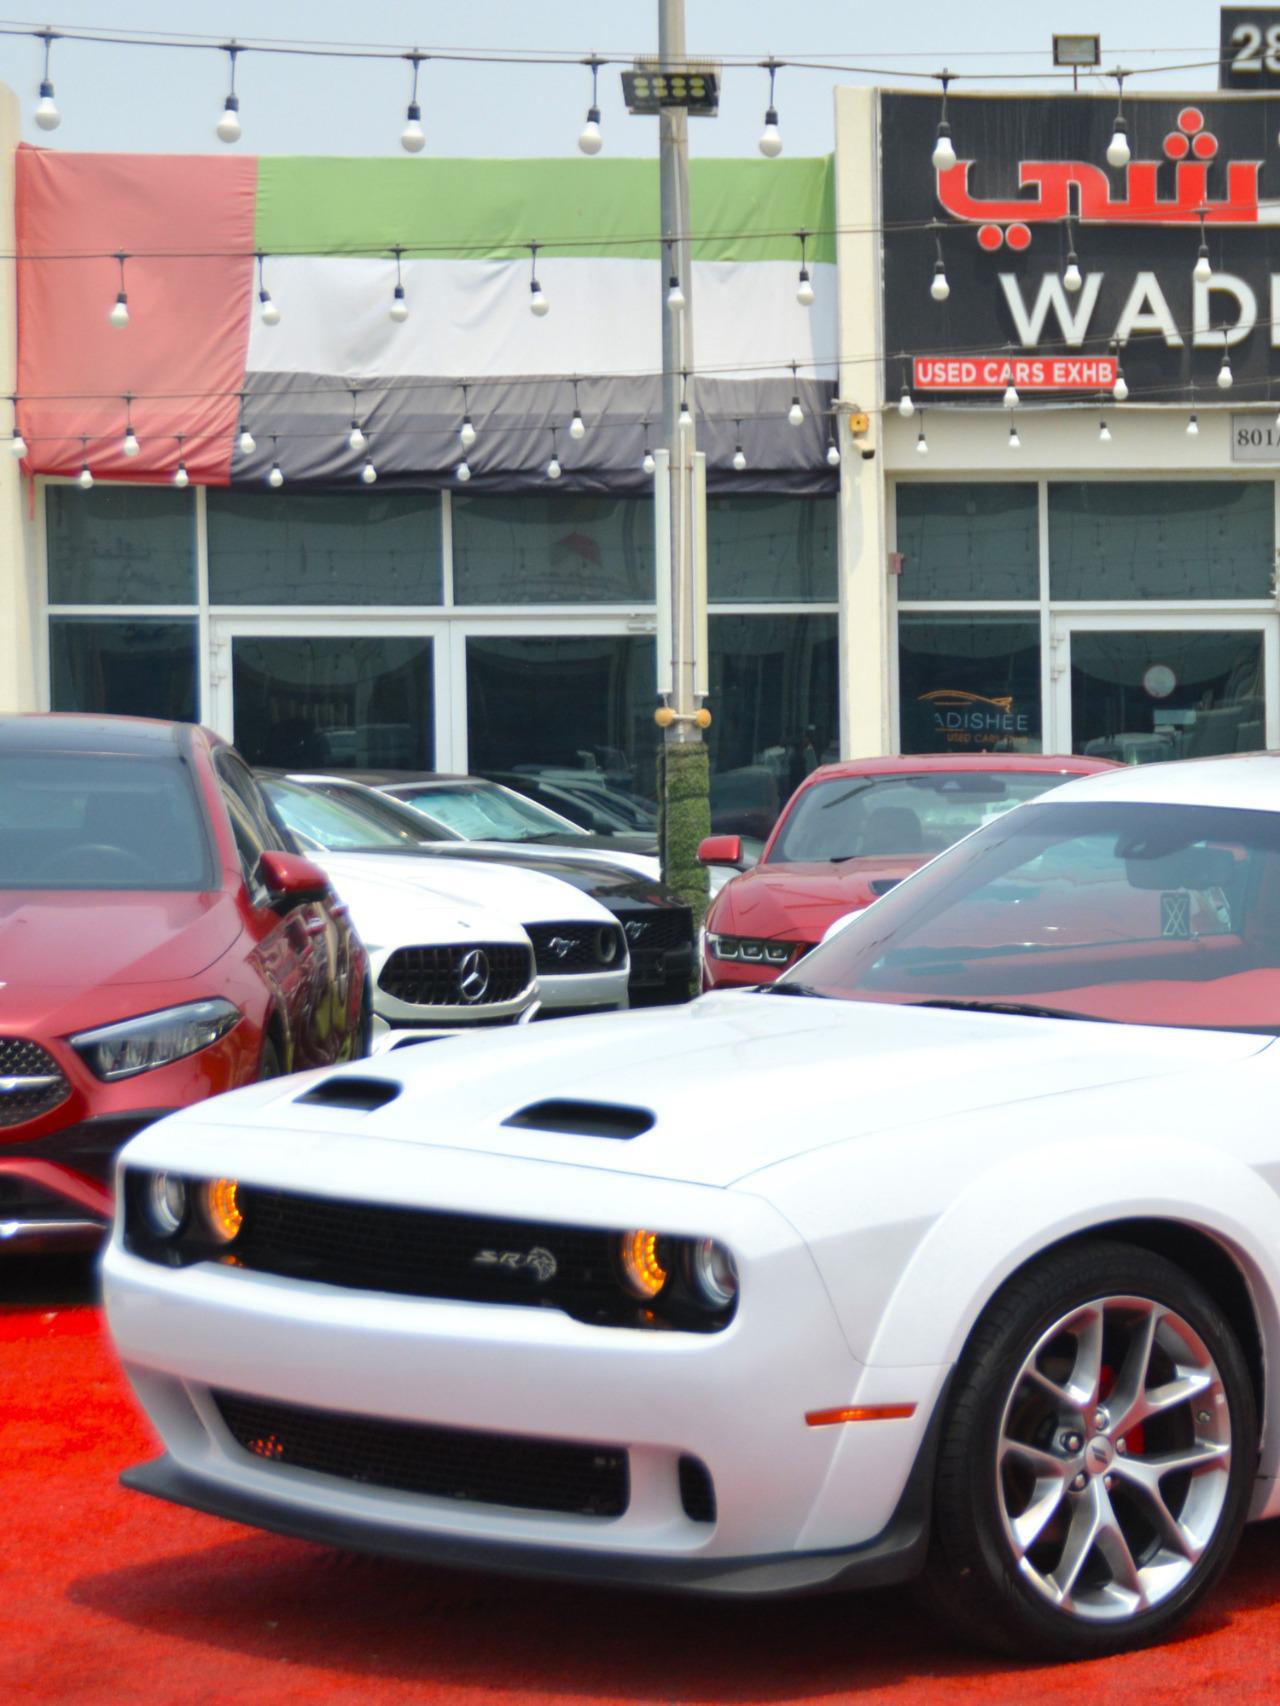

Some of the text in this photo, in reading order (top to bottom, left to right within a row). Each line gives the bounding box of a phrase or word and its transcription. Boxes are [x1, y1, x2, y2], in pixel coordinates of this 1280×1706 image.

[917, 362, 1113, 384] USED CARS EXHB
